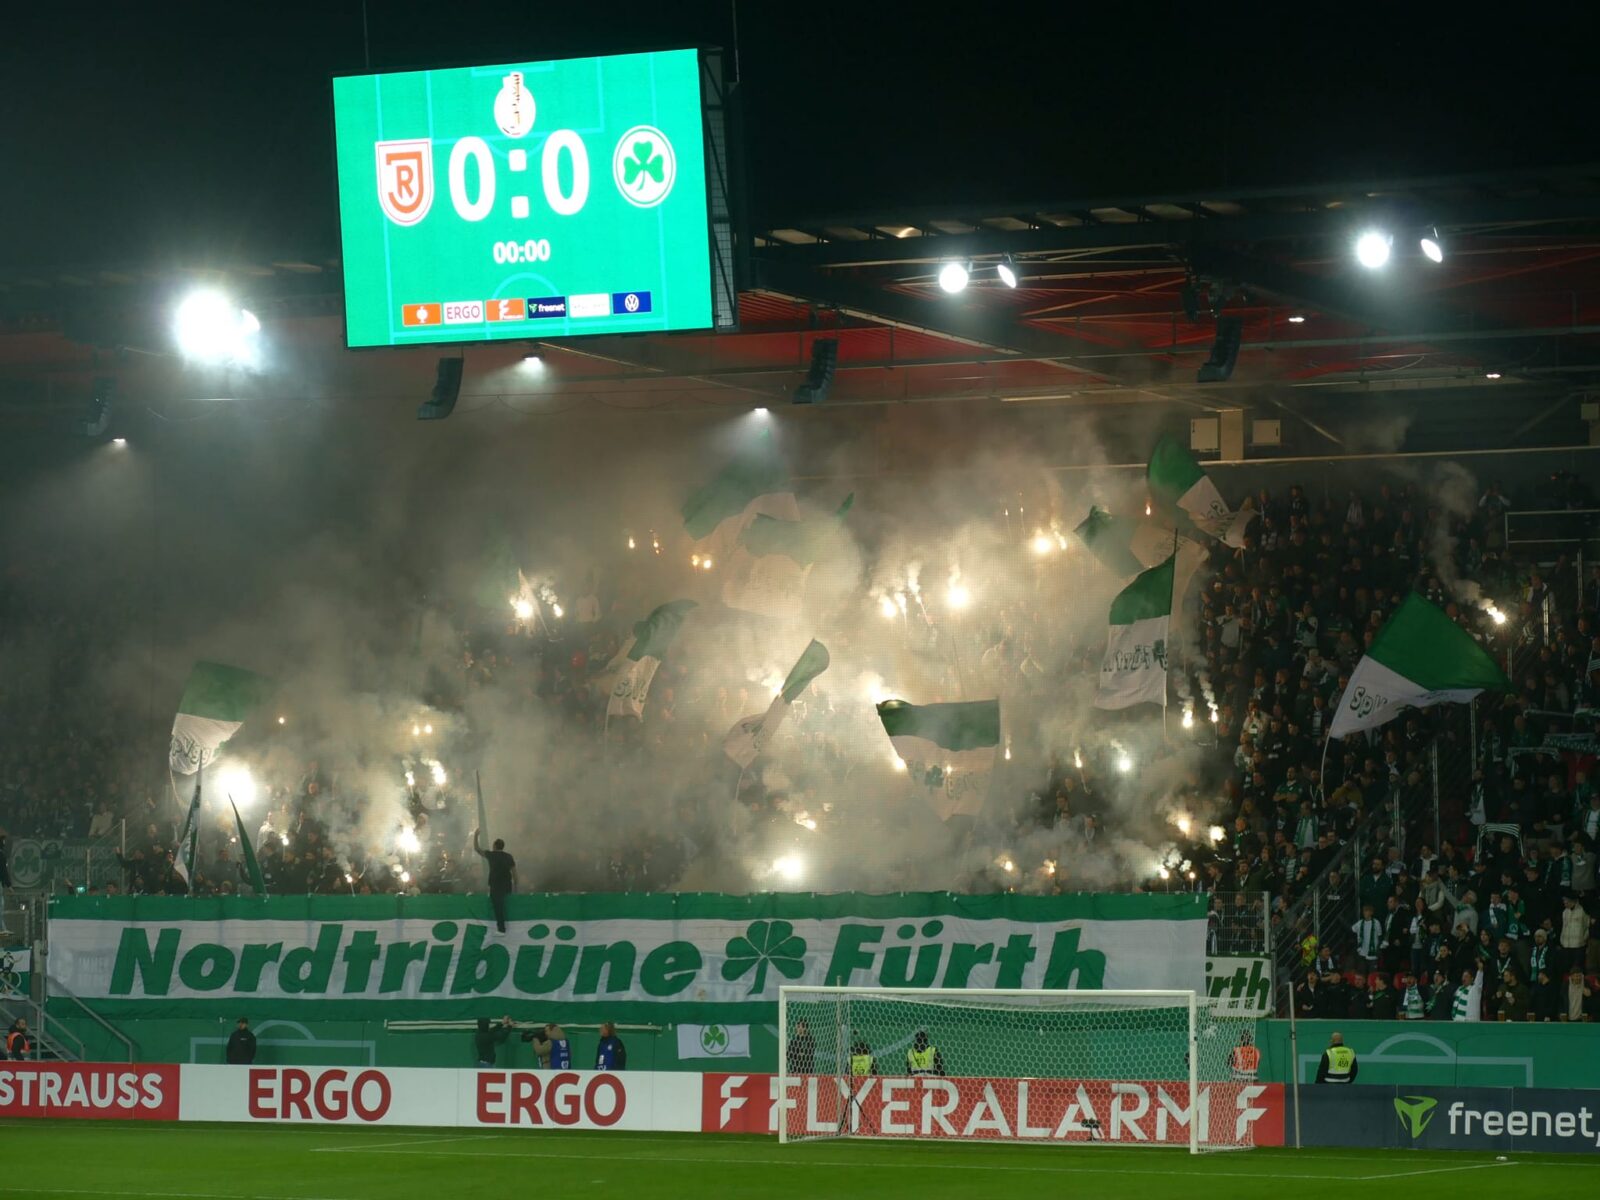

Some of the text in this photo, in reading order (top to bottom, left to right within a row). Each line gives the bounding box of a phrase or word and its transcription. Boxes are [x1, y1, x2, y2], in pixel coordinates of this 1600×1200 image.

[493, 239, 551, 264] 00:00
[446, 304, 481, 320] ERGO
[538, 302, 566, 313] freenet
[109, 920, 1108, 998] Nordtribüne Fürth
[0, 1070, 164, 1109] STRAUSS
[248, 1068, 391, 1122] ERGO
[476, 1072, 626, 1127] ERGO
[768, 1076, 1210, 1142] FLYERALARM
